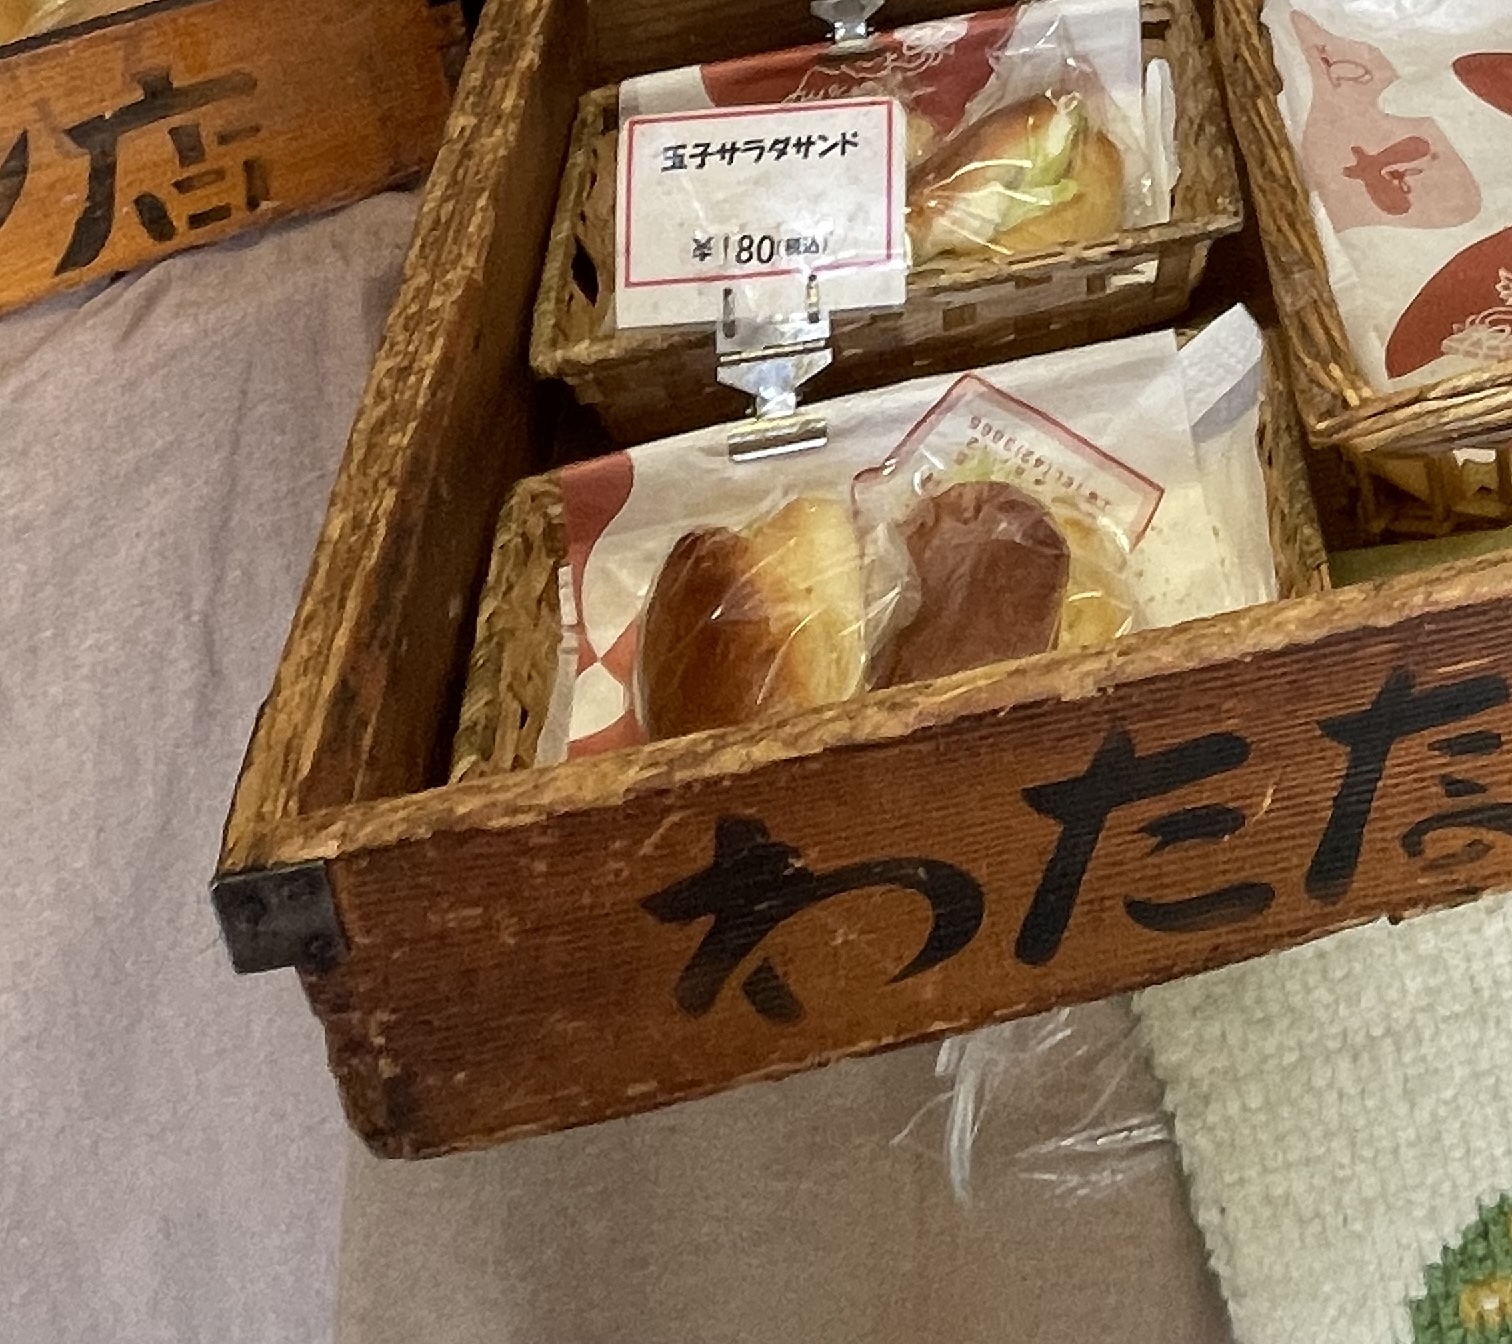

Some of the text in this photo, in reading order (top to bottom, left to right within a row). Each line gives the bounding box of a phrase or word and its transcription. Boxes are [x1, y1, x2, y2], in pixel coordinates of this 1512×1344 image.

[660, 130, 860, 173] 玉子サラダサンド
[691, 233, 775, 264] ¥180
